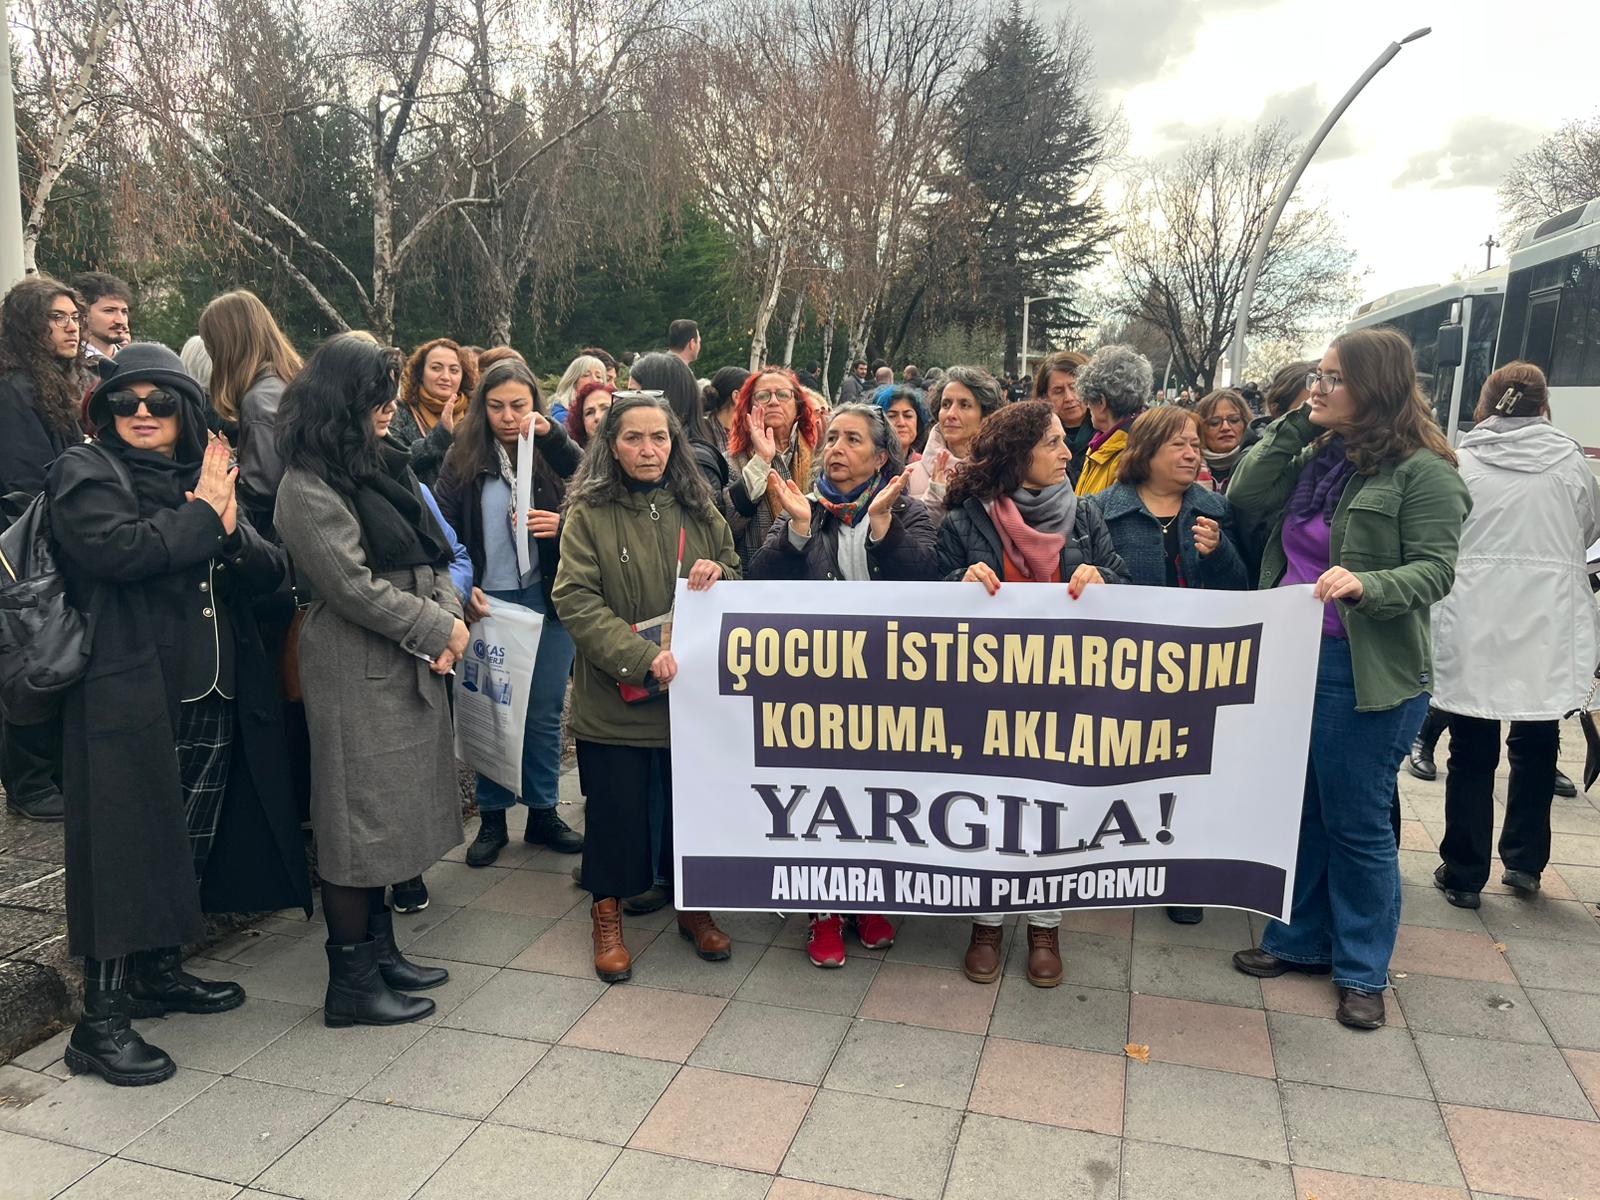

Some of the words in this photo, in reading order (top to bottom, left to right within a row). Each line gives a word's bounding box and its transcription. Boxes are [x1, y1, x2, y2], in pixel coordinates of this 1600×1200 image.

[726, 627, 869, 691] ÇOCUK
[886, 621, 1252, 694] İSTİSMARCISINI
[762, 702, 963, 761] KORUMA,
[983, 709, 1190, 768] AKLAMA;
[751, 783, 1178, 858] YARGILA!
[771, 865, 886, 903] ANKARA
[895, 869, 981, 907] KADIN
[991, 866, 1167, 907] PLATFORMU
